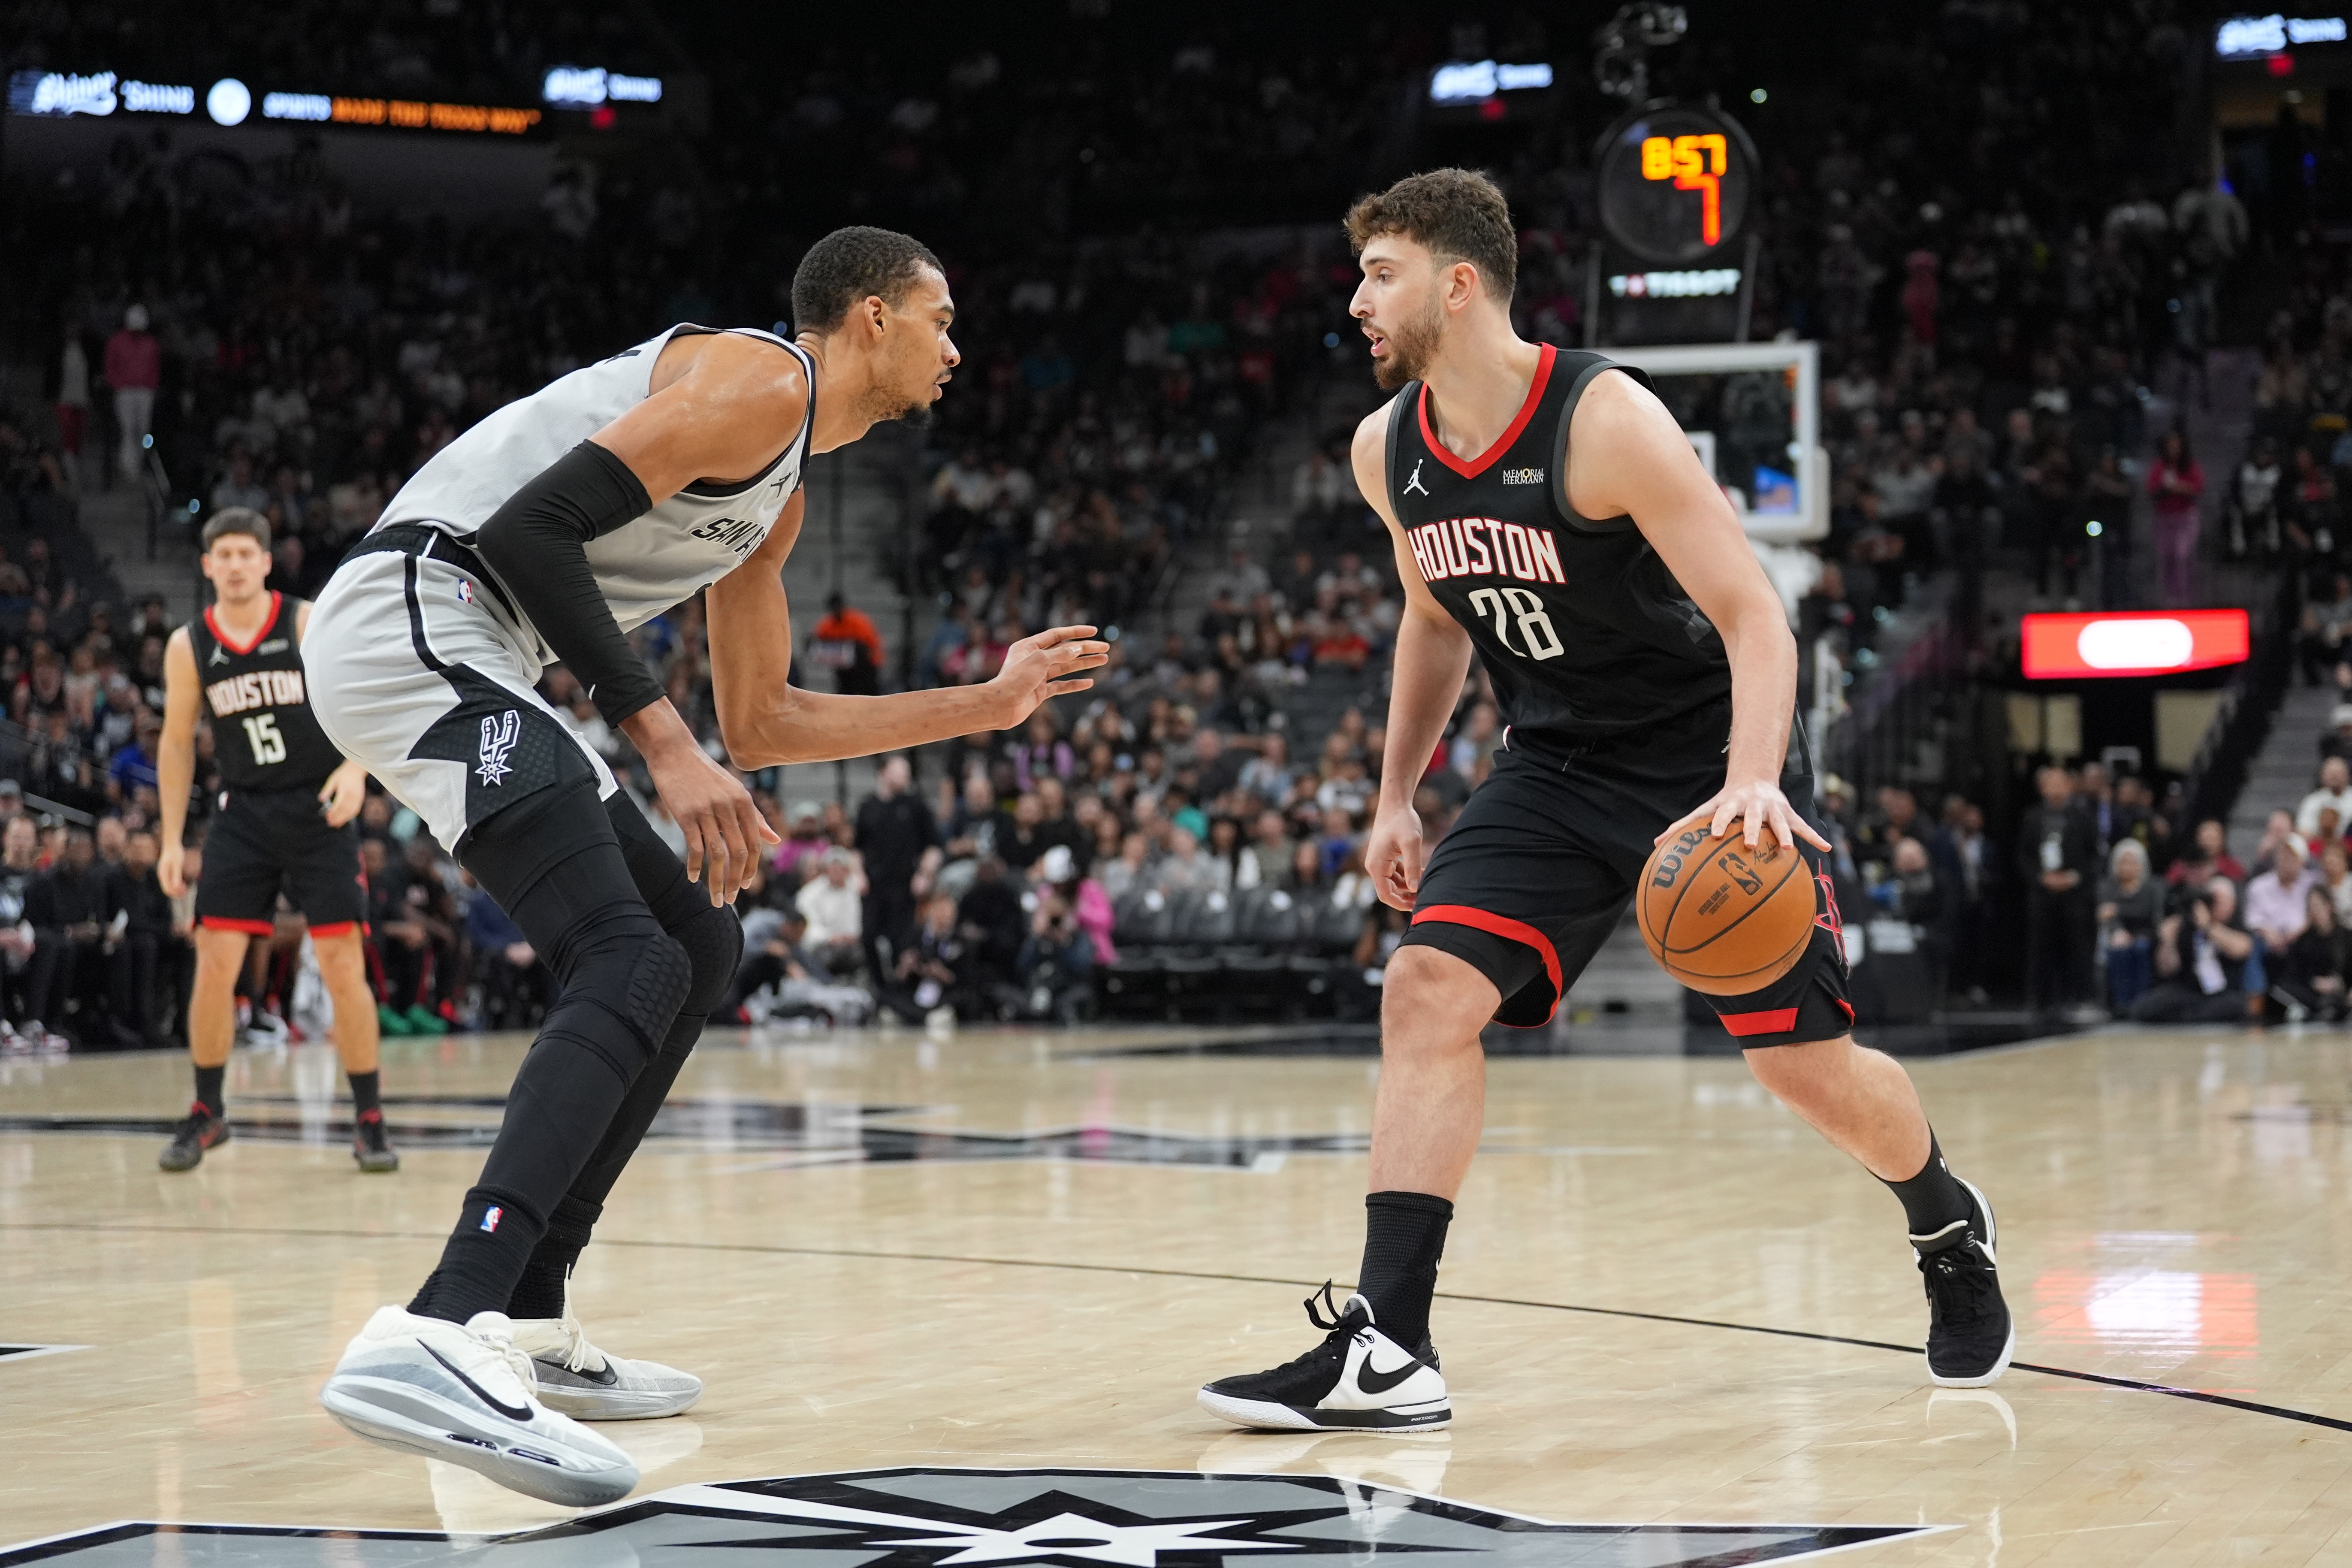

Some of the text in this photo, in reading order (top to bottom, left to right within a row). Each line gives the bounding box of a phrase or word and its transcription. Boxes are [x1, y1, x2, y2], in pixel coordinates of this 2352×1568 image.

[1503, 468, 1544, 478] MEMORIAL
[1503, 476, 1544, 485] HERMANN
[688, 517, 760, 547] SAN
[1407, 517, 1567, 584] HOUSTON
[206, 670, 304, 718] HOUSTON
[242, 712, 287, 766] 15
